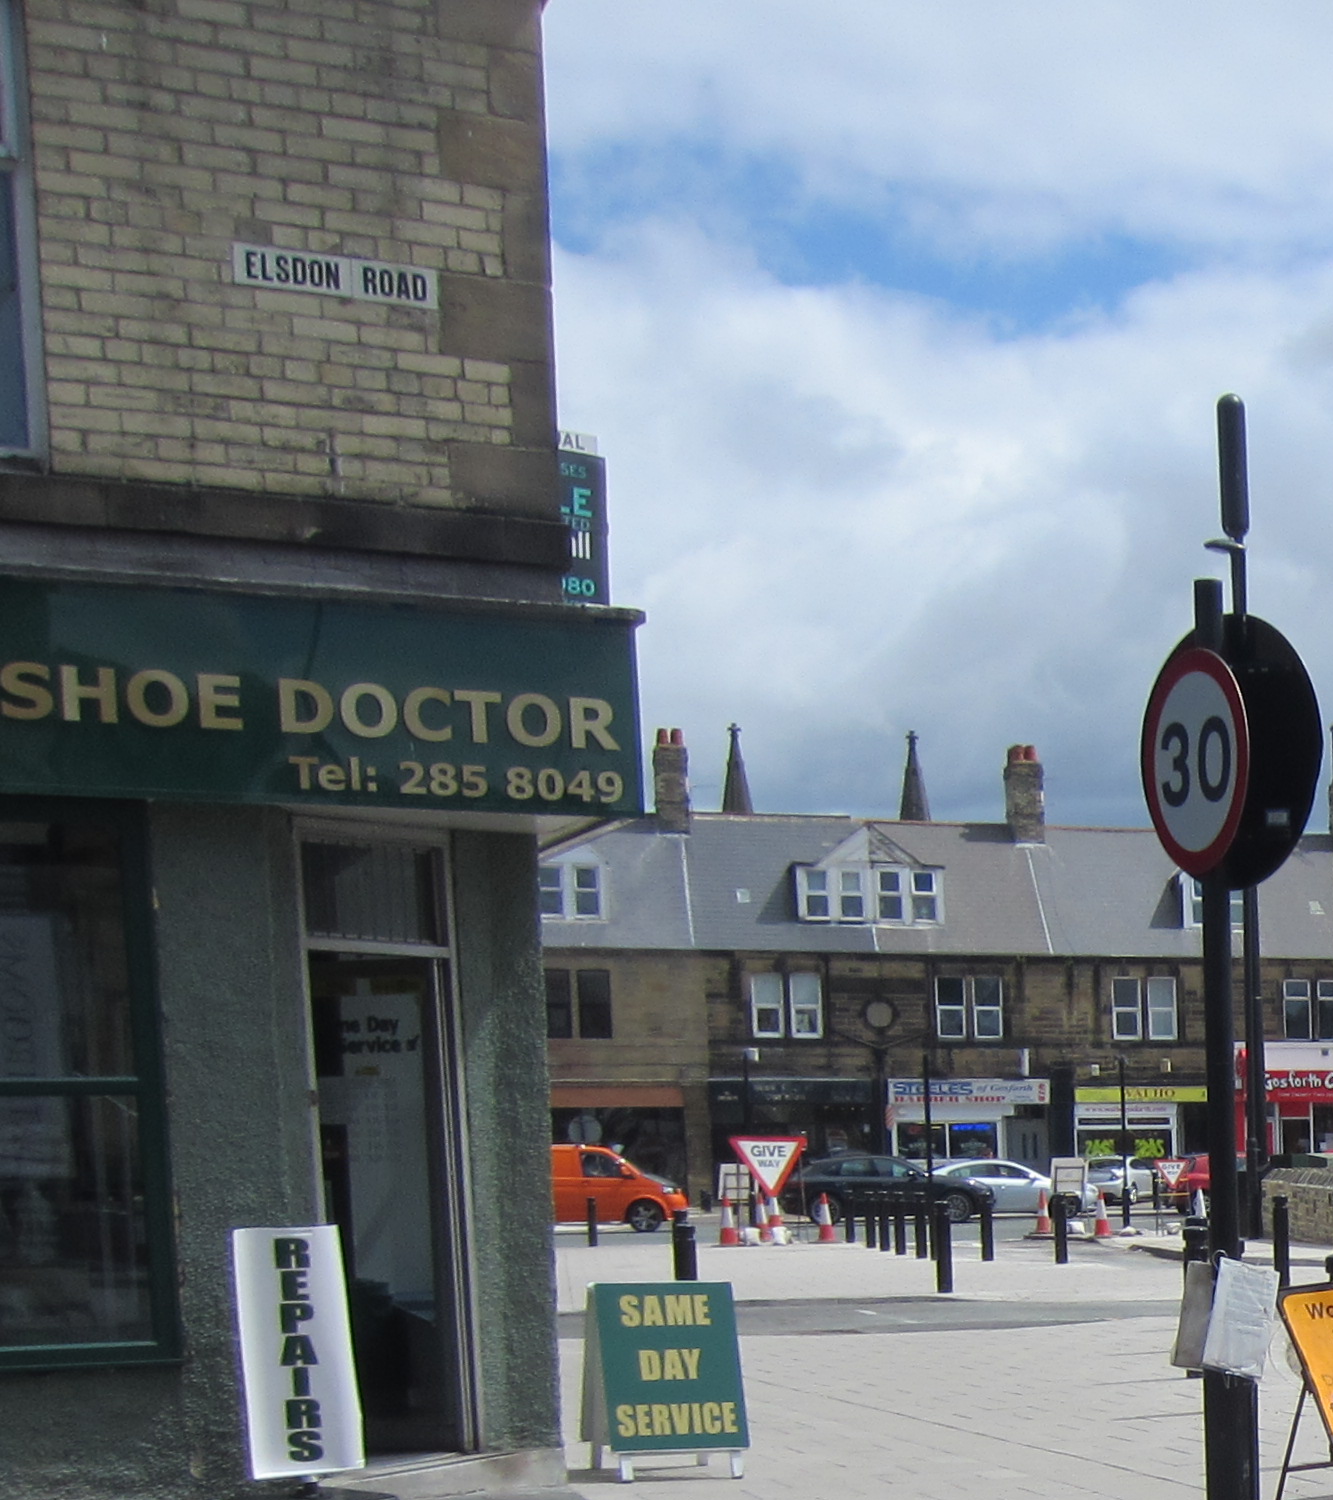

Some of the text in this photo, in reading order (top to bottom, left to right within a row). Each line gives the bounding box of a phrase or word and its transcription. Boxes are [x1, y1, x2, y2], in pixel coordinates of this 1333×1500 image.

[245, 251, 427, 301] ELSDON ROAD
[0, 661, 621, 751] SHOE DOCTOR
[1161, 715, 1231, 808] 30
[290, 756, 625, 803] Tel: 285 8049
[367, 1016, 400, 1035] Day
[751, 1145, 787, 1157] GIVE
[758, 1159, 781, 1168] WAY
[619, 1294, 711, 1327] SAME
[274, 1238, 324, 1462] REPAIRS
[638, 1349, 701, 1380] DAY
[616, 1402, 739, 1437] SERVICE
